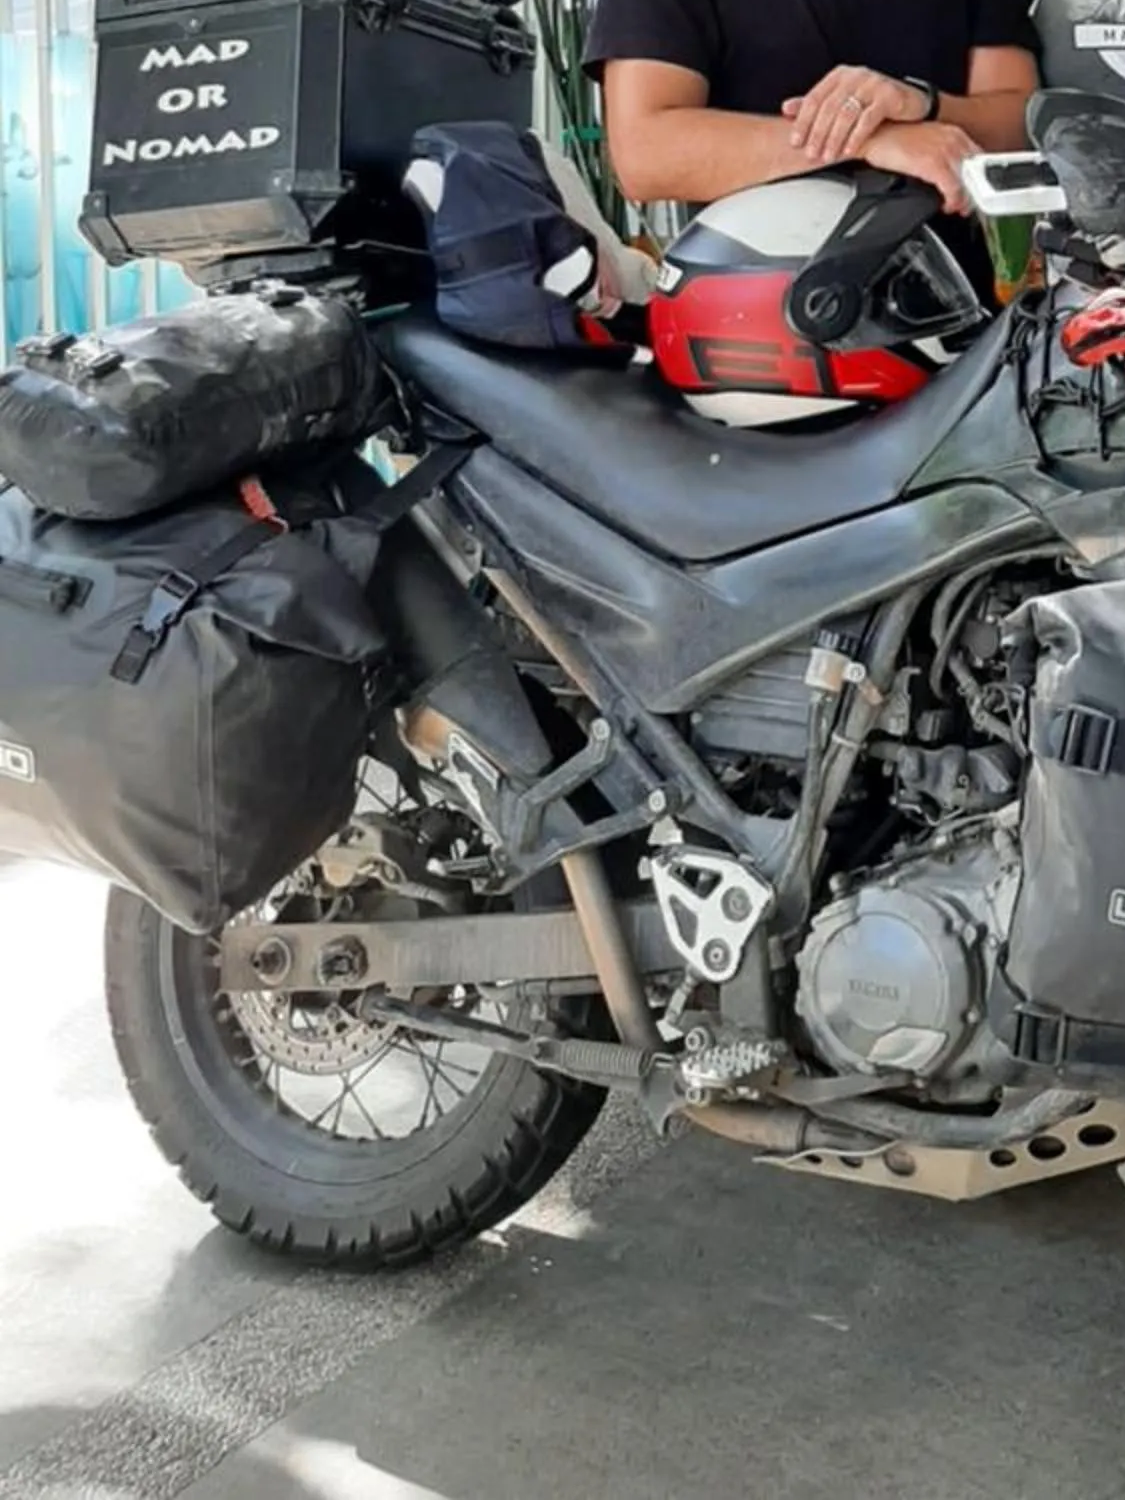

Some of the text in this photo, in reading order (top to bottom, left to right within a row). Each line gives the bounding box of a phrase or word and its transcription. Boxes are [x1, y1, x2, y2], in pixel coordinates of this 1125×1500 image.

[139, 39, 249, 72] MAD
[157, 83, 228, 113] OR
[102, 126, 280, 166] NOMAD
